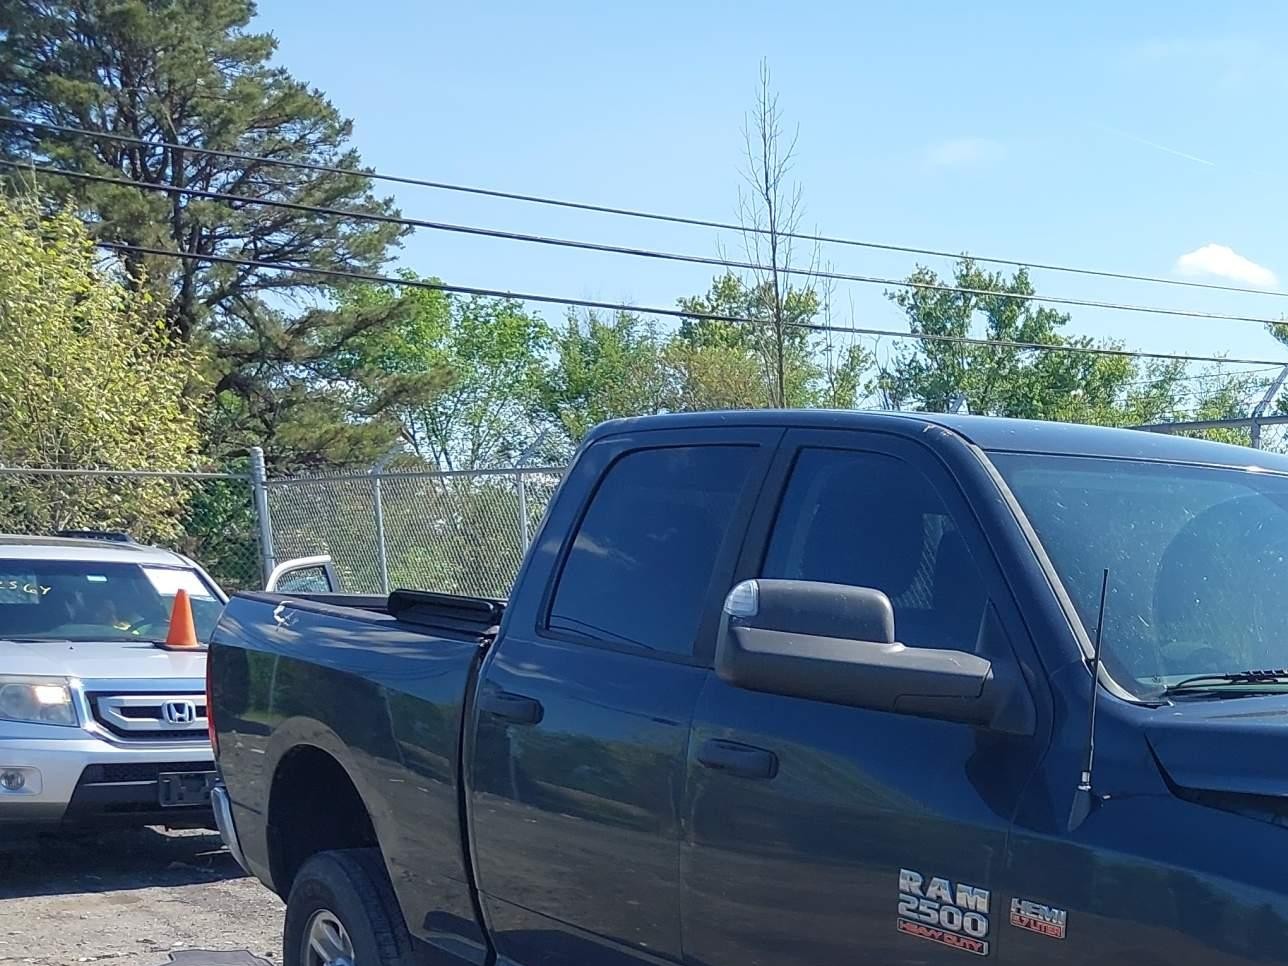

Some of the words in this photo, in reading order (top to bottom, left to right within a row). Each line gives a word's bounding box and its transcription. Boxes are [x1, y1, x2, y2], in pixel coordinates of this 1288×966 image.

[899, 868, 989, 913] RAM
[898, 893, 989, 937] 2500
[1011, 897, 1067, 925] HEMI
[899, 920, 943, 939] HEAVY
[943, 931, 983, 952] DUTY
[1030, 919, 1062, 938] LITER
